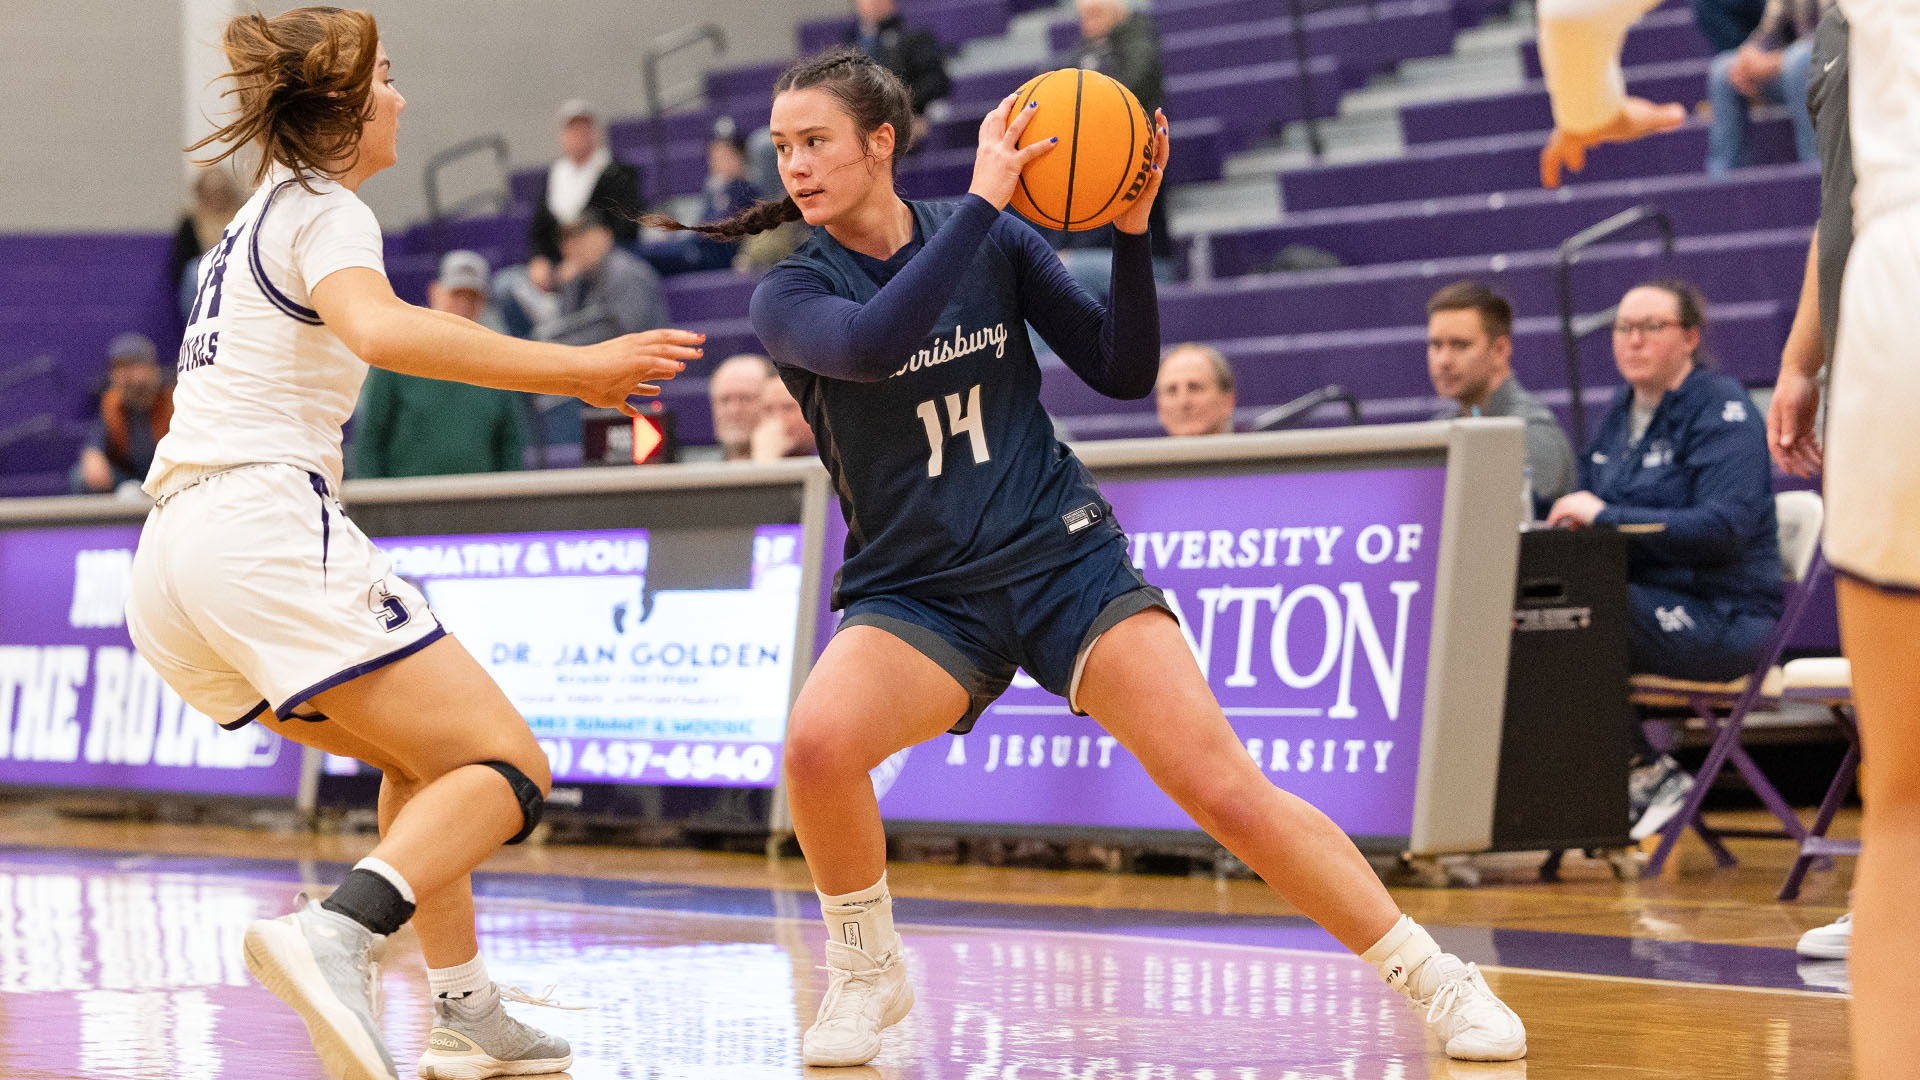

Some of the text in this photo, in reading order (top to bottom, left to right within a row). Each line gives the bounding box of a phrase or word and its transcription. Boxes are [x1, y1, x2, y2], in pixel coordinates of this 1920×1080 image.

[917, 383, 990, 478] 14
[379, 544, 522, 576] ODIATRY
[555, 539, 648, 572] WOU
[1128, 523, 1424, 570] IVERSITY OF
[555, 642, 617, 667] JAN
[630, 641, 781, 669] GOLDEN
[1163, 580, 1421, 722] NTON
[984, 734, 1118, 773] JESUIT
[1246, 738, 1394, 774] ERSITY
